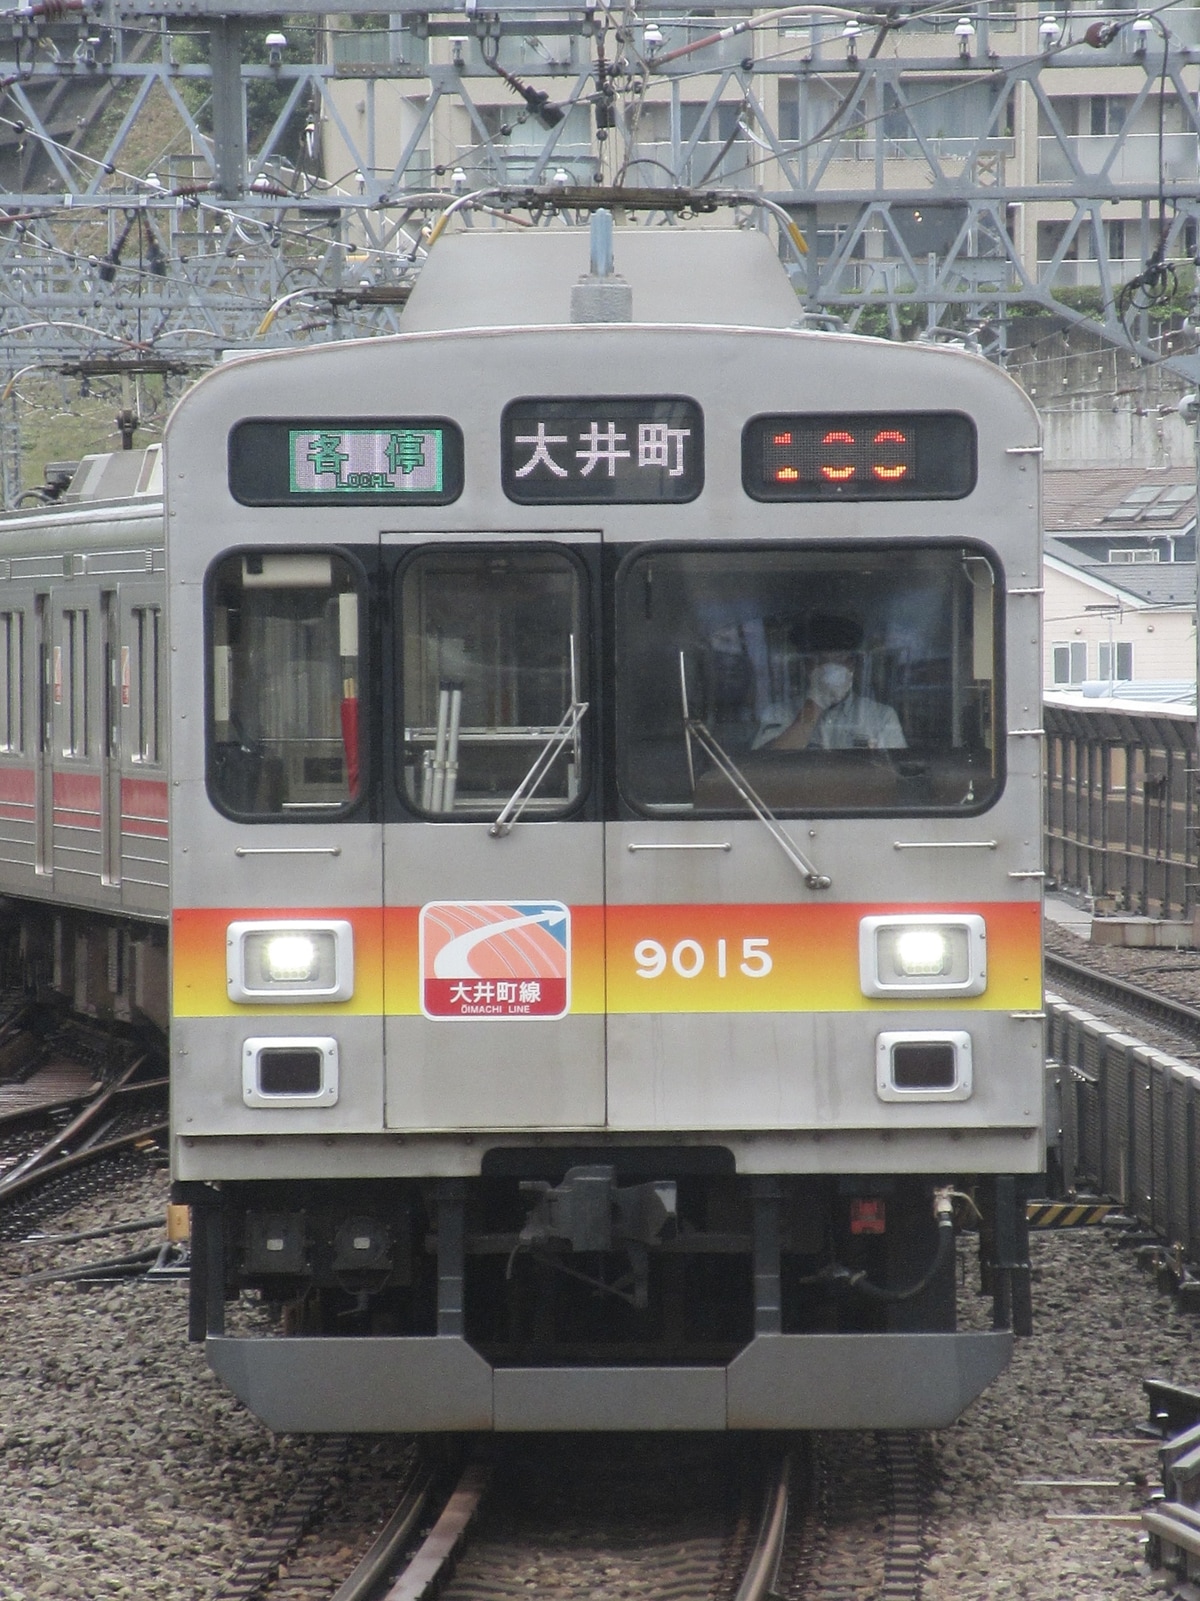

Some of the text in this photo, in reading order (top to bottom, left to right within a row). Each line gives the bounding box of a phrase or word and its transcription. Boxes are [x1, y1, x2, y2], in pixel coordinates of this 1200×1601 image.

[306, 433, 425, 475] 各停
[515, 421, 691, 477] 大井町
[336, 472, 395, 489] LOCAL
[634, 938, 773, 979] 9015
[449, 981, 542, 1004] 大井町線
[508, 1005, 531, 1014] LINE
